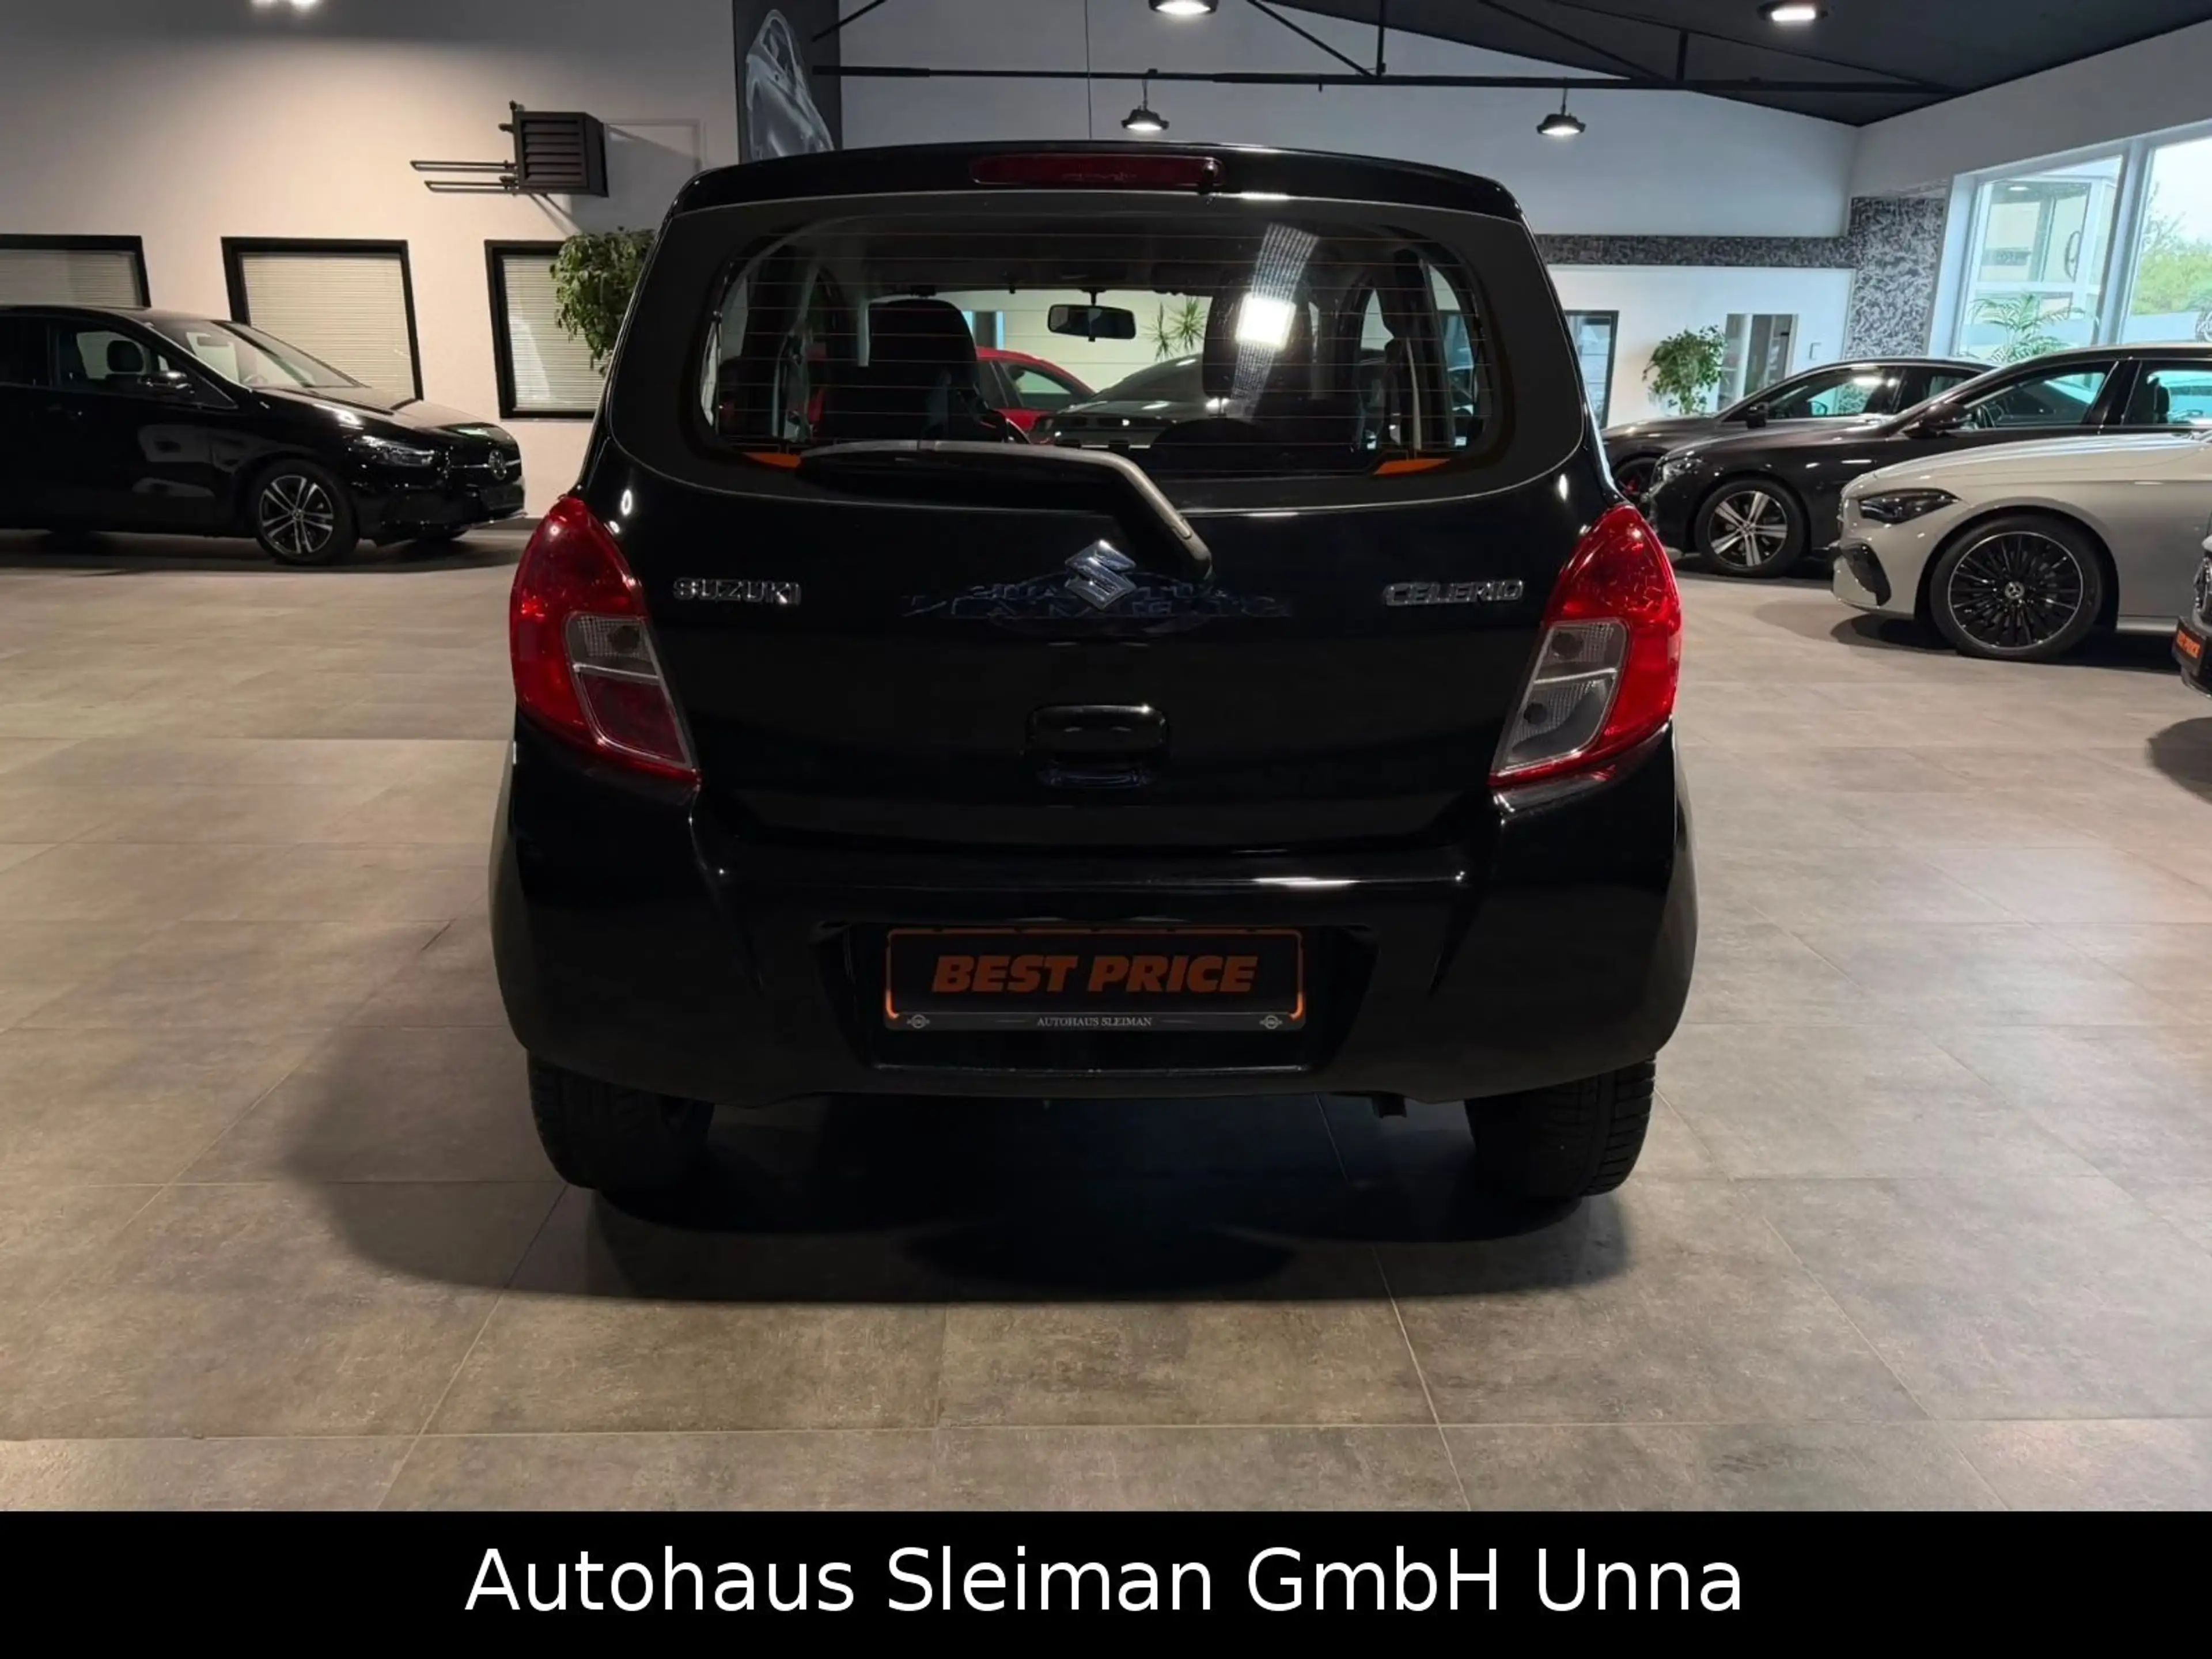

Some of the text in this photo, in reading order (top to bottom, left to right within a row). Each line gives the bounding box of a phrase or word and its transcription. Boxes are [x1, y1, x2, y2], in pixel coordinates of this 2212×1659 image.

[673, 577, 801, 605] SUZUKI
[1383, 579, 1524, 607] CELERIO
[931, 955, 1258, 993] BEST PRICE
[1037, 1017, 1152, 1027] AUTOHAUS SLEIMAN
